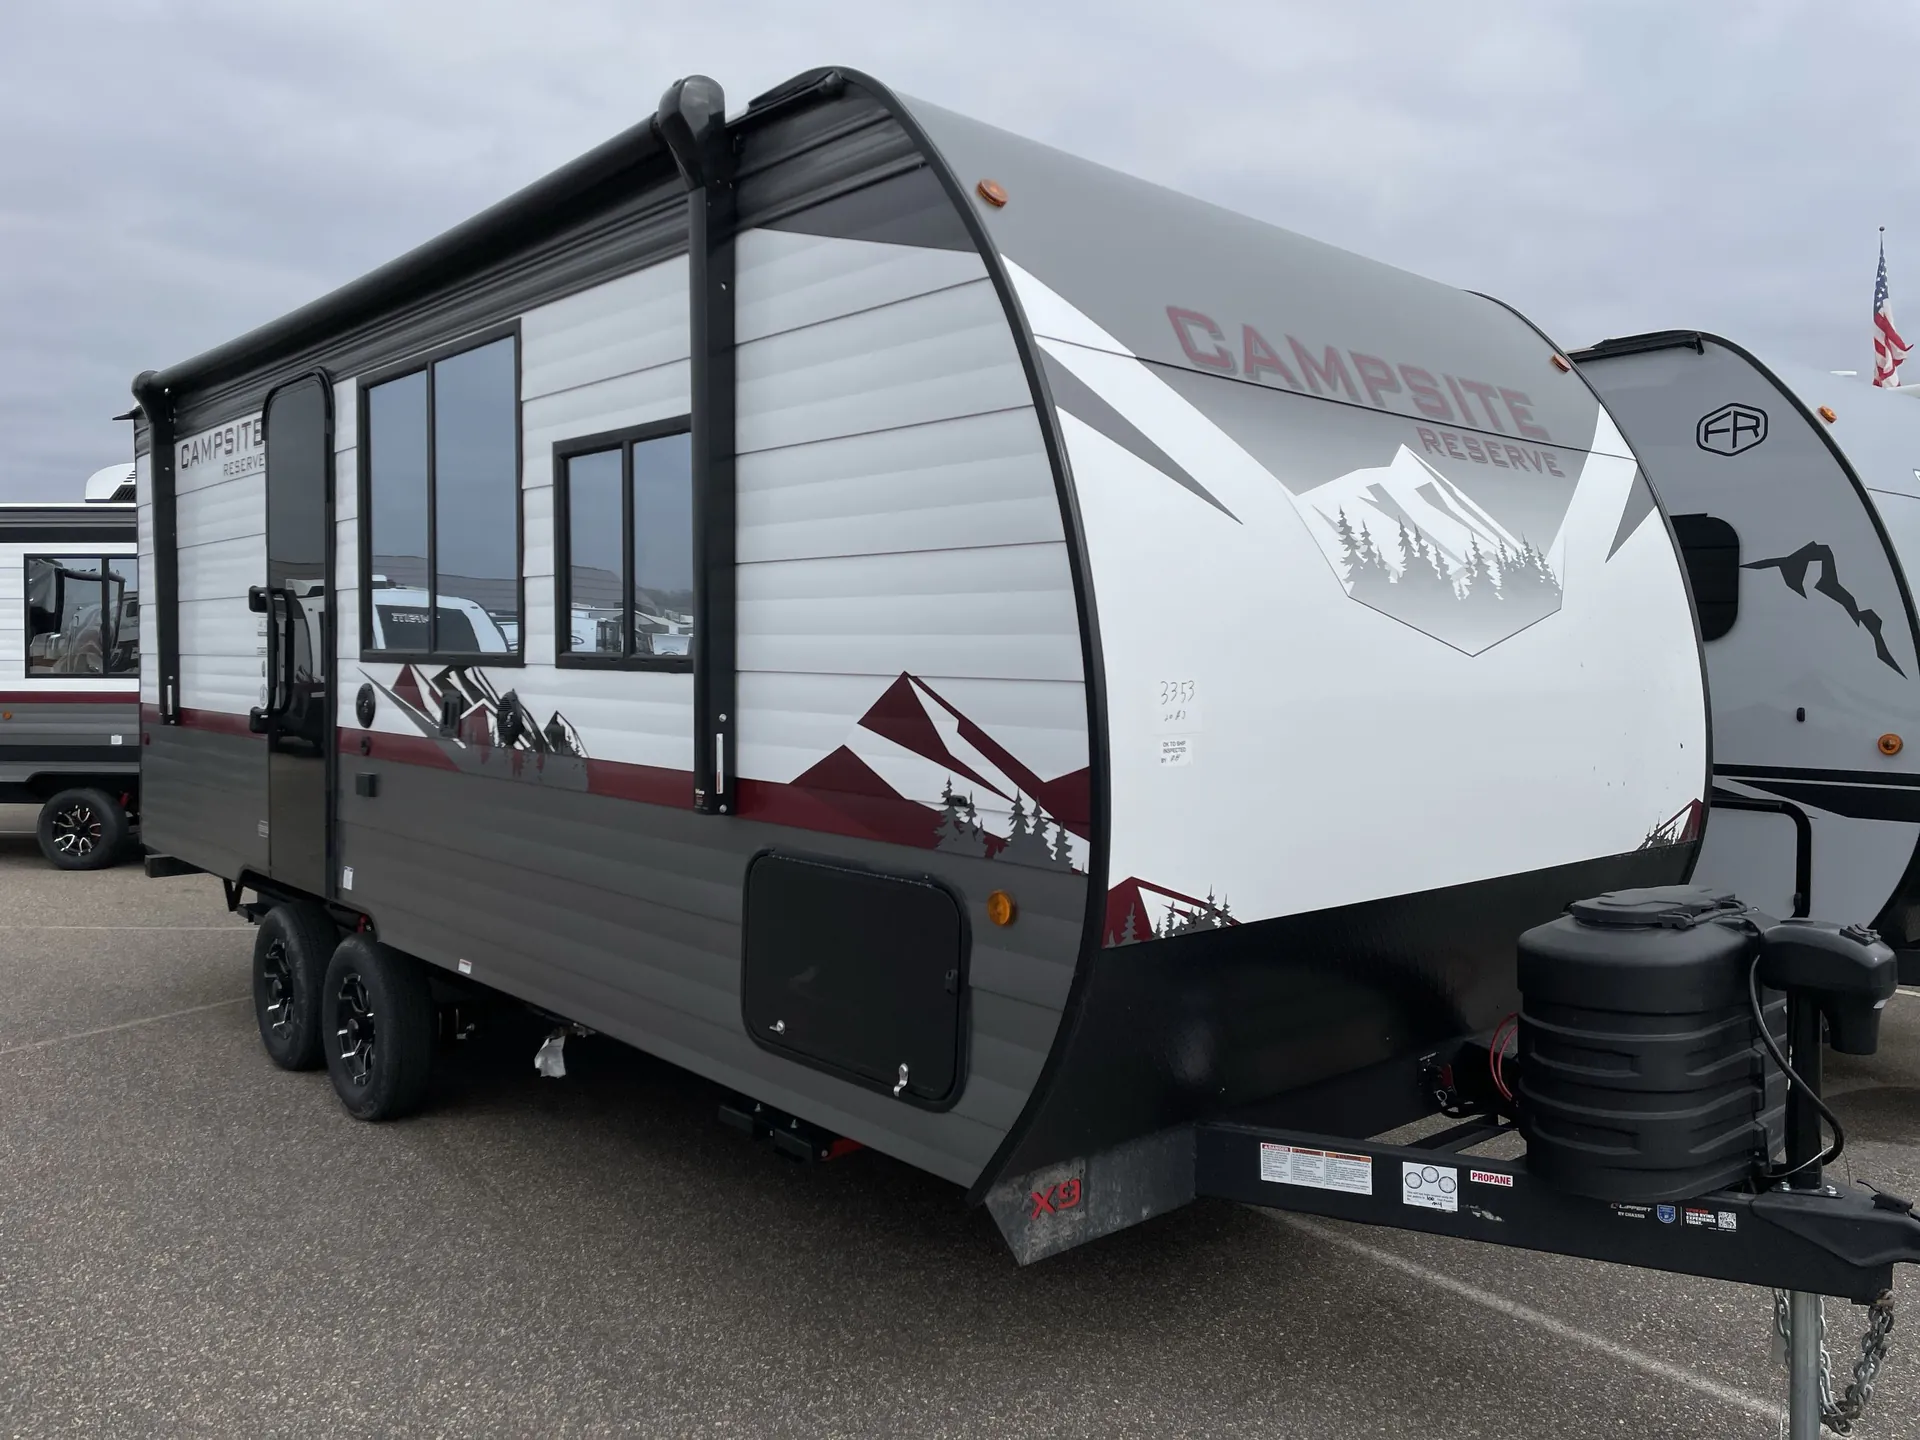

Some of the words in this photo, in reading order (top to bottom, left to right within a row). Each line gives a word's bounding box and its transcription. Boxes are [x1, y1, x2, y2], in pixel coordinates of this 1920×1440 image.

[1166, 306, 1551, 442] CAMPSITE
[181, 418, 263, 470] CAMPSITE
[1415, 426, 1566, 478] RESERVE
[223, 452, 265, 477] RESERVE
[1160, 680, 1195, 705] 3353
[1472, 1172, 1512, 1186] PROPANE
